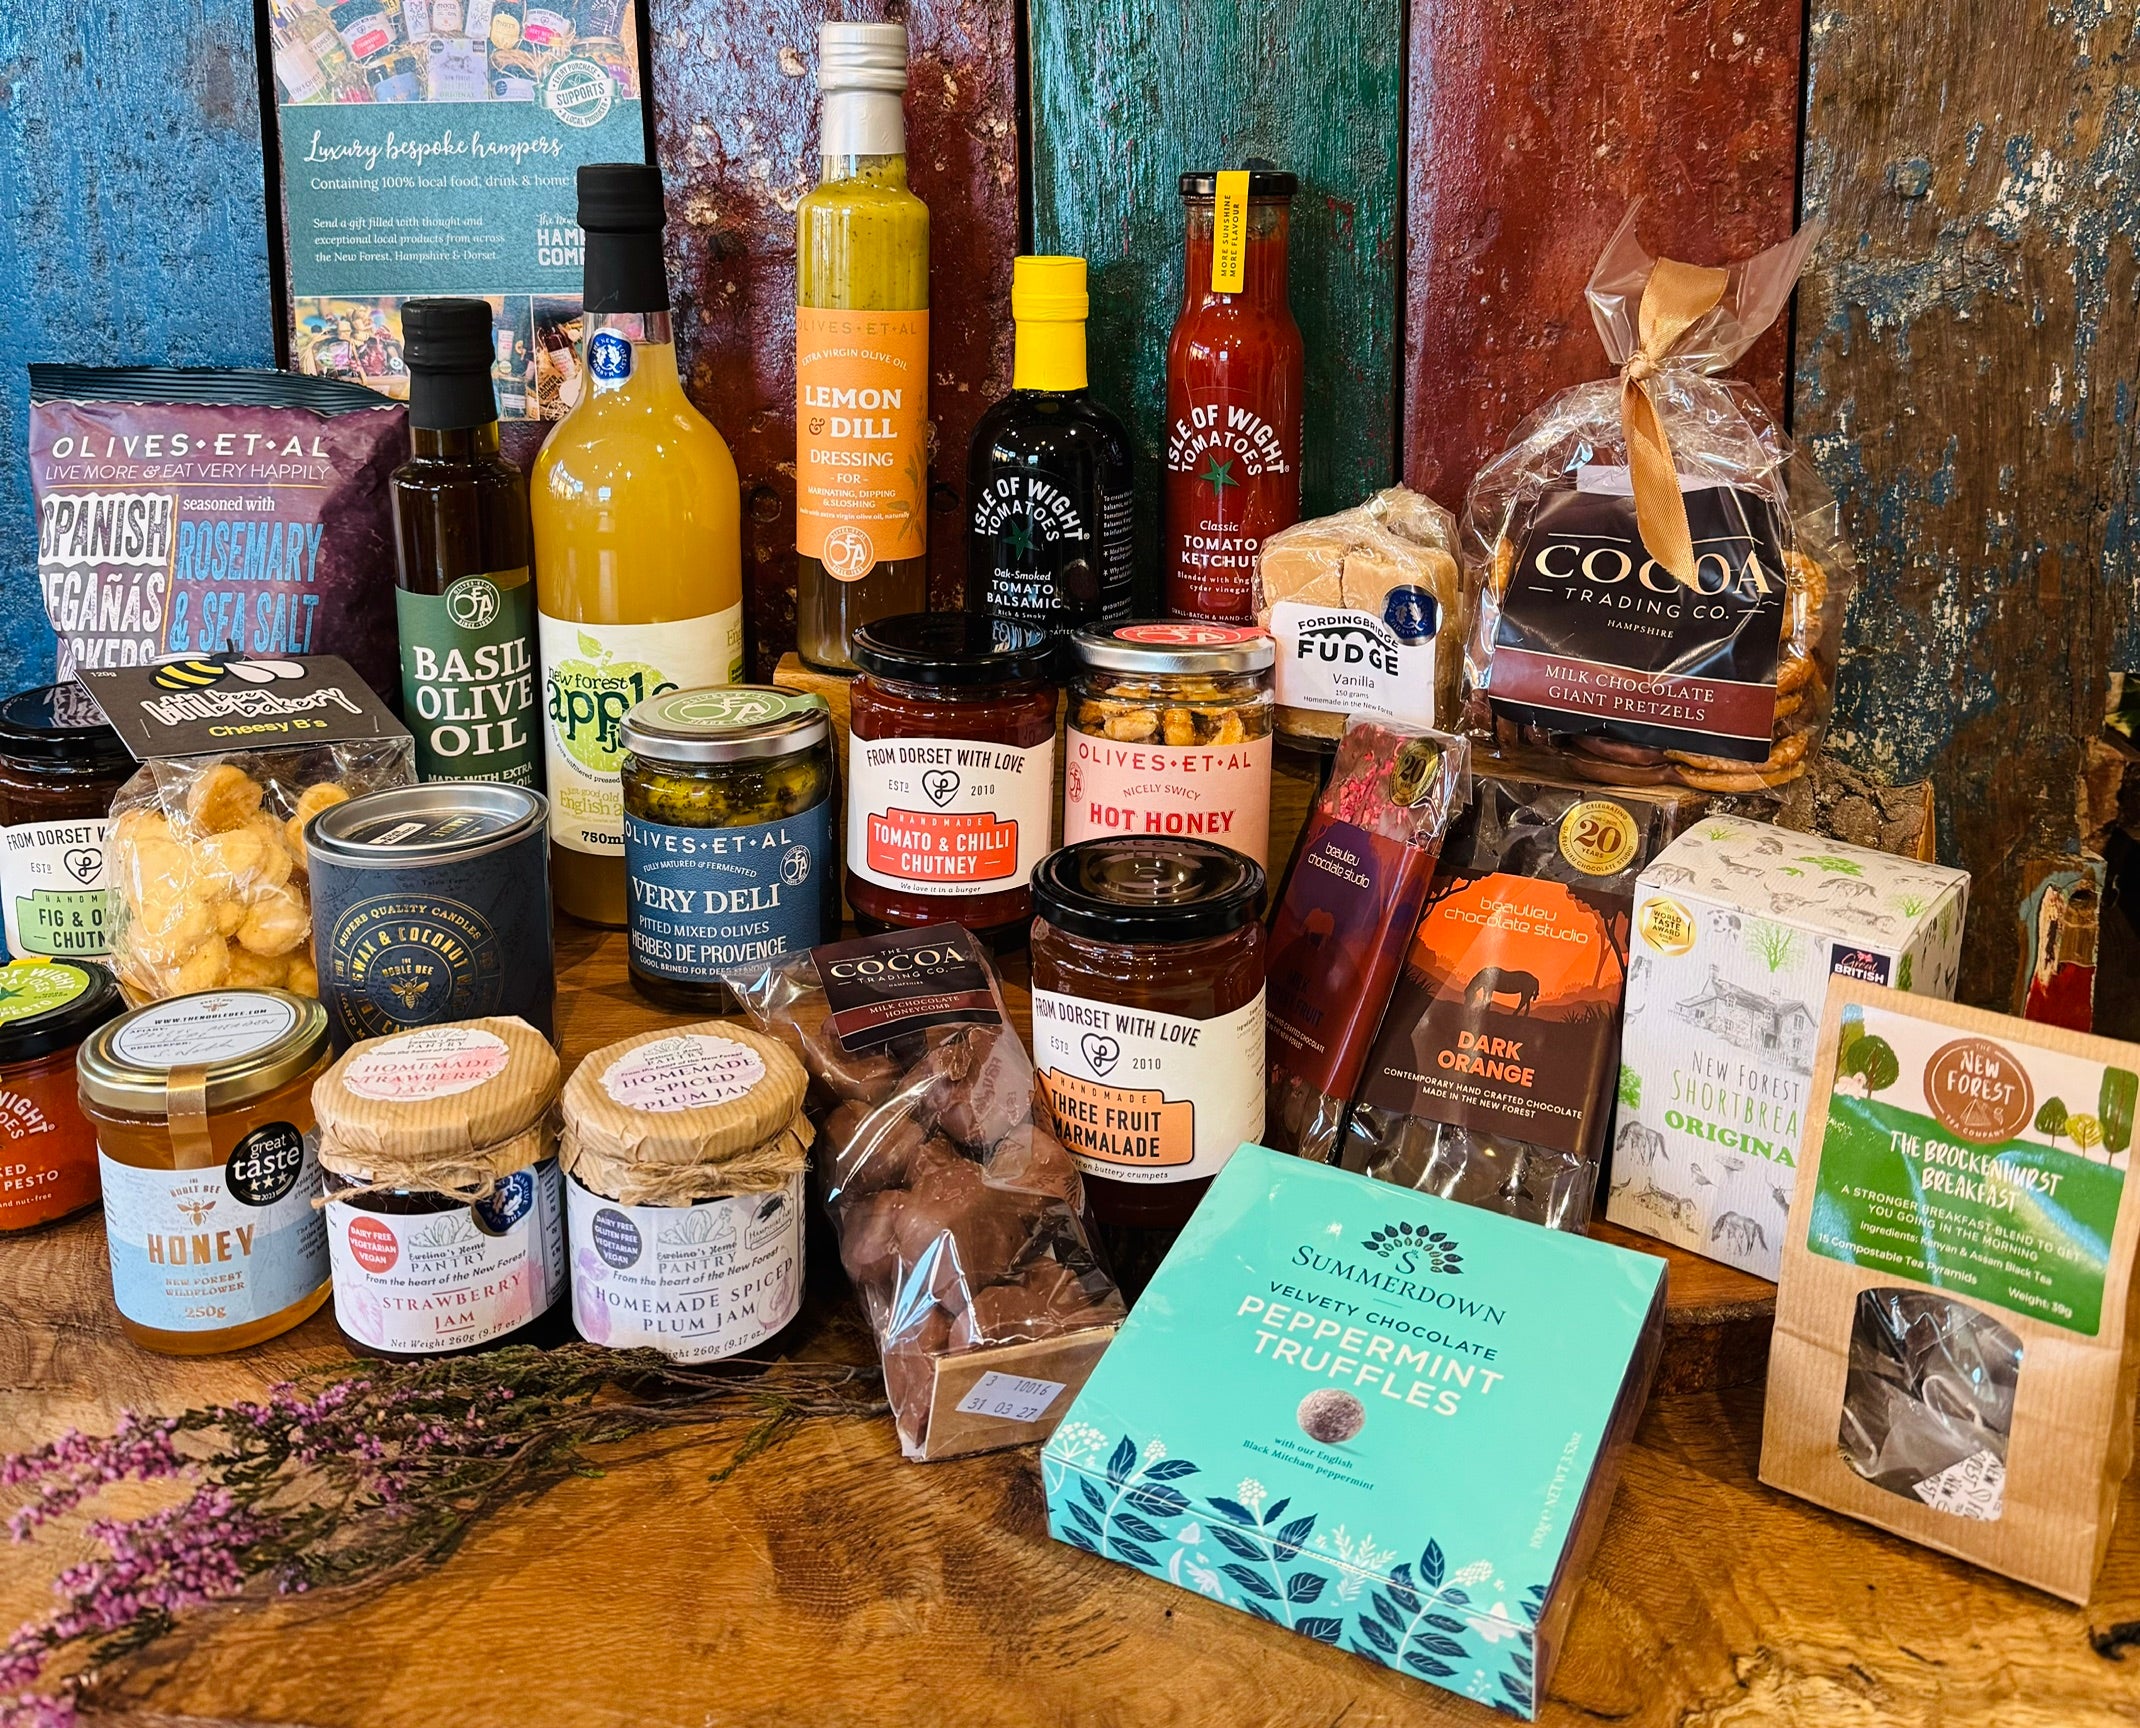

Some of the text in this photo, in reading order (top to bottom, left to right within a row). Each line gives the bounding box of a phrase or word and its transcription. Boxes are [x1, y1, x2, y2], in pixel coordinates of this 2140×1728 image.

[557, 82, 604, 106] SUPPORTS
[305, 130, 562, 169] Luxury bespoke hampers
[311, 175, 569, 192] Containing 100% local food, drink & home
[1223, 195, 1231, 244] SUNSHINE
[316, 250, 332, 261] the
[334, 250, 357, 261] New
[360, 250, 392, 262] Forest,
[395, 249, 450, 264] Hampshire
[463, 250, 495, 260] Dorset
[802, 349, 907, 371] EXTRA VIRGIN OLIVE OIL
[805, 385, 902, 409] LEMON
[809, 417, 897, 439] & DILL
[1168, 419, 1191, 472] ISLE
[1192, 405, 1218, 428] OF
[810, 449, 893, 467] DRESSING
[1182, 431, 1262, 476] TOMATOES
[46, 465, 79, 480] LIVE
[83, 465, 138, 480] MORE
[163, 463, 193, 478] EAT
[197, 463, 246, 480] VERY
[251, 464, 329, 480] HAPPILY
[184, 496, 275, 512] seasoned with
[41, 499, 171, 558] SPANISH
[1200, 521, 1239, 532] Classic
[176, 521, 323, 582] ROSEMARY
[1184, 535, 1257, 551] TOMATO
[995, 568, 1051, 581] Oak-Smoked
[1535, 544, 1772, 596] COCOA
[987, 592, 1061, 609] BALSAMIC
[992, 580, 1053, 594] TOMATO
[1565, 587, 1729, 620] TRADING CO.
[170, 591, 319, 654] & SEA SALT
[1298, 615, 1399, 648] FORDINGBRIDGE
[1607, 619, 1674, 639] HAMPSHIRE
[413, 637, 531, 682] BASIL
[1298, 640, 1399, 676] FUDGE
[549, 667, 628, 690] new forest
[1333, 673, 1375, 688] Vanilla
[1545, 665, 1714, 703] MILK CHOCOLATE
[416, 673, 533, 721] OLIVE
[1304, 696, 1341, 706] Homemade
[1364, 702, 1376, 710] New
[1349, 691, 1368, 699] grams
[1549, 686, 1706, 722] GIANT PRETZELS
[209, 720, 289, 737] Cheesy
[431, 718, 527, 757] OIL
[867, 748, 1025, 774] FROM DORSET WITH LOVE
[971, 784, 995, 797] 2010
[1123, 784, 1201, 801] NICELY SWICY
[1090, 802, 1235, 834] HOT HONEY
[874, 823, 1009, 852] TOMATO & CHILLI
[1574, 820, 1622, 854] 20
[901, 854, 977, 875] CHUTNEY
[632, 876, 781, 914] VERY DELI
[1480, 896, 1557, 921] beaulieu
[39, 908, 84, 927] FIG &
[339, 904, 481, 947] SUPERB QUALITY CANDLES
[639, 914, 770, 938] PITTED MIXED OLIVES
[1444, 906, 1588, 944] chocolate studio
[1654, 917, 1681, 931] TASTE
[831, 946, 965, 979] COCOA
[857, 967, 949, 984] TRADING CO.
[1835, 963, 1884, 984] BRITISH
[885, 1003, 951, 1019] HONEYCOMB
[1457, 1030, 1524, 1061] DARK
[1437, 1050, 1535, 1088] ORANGE
[1960, 1050, 2001, 1076] NEW
[1422, 1086, 1536, 1119] MADE IN THE NEW FOREST
[1947, 1069, 2016, 1106] FOREST
[1051, 1088, 1161, 1133] THREE FRUIT
[250, 1133, 287, 1160] great
[1053, 1119, 1160, 1158] MARMALADE
[232, 1145, 301, 1180] taste
[1890, 1130, 2063, 1197] THE BROCKENHURST
[4, 1169, 59, 1191] PESTO
[1921, 1167, 2019, 1214] BREAKFAST
[1841, 1185, 2081, 1262] A STRONGER BREAKFAST BLEND TO GET
[1868, 1204, 2039, 1262] YOU GOING IN THE MORNING
[147, 1223, 255, 1264] HONEY
[382, 1272, 521, 1311] STRAWBERRY
[596, 1257, 793, 1313] HOMEMADE SPICED
[1291, 1245, 1507, 1325] SUMMERDOWN
[184, 1305, 226, 1319] 250g
[435, 1312, 475, 1329] JAM
[643, 1303, 755, 1333] PLUM JAM
[1270, 1280, 1497, 1361] VELVETY CHOCOLATE
[1236, 1295, 1504, 1394] PEPPERMINT
[1014, 1380, 1052, 1395] 10016
[1254, 1330, 1462, 1416] TRUFFLES
[968, 1398, 1038, 1419] 31 03 27
